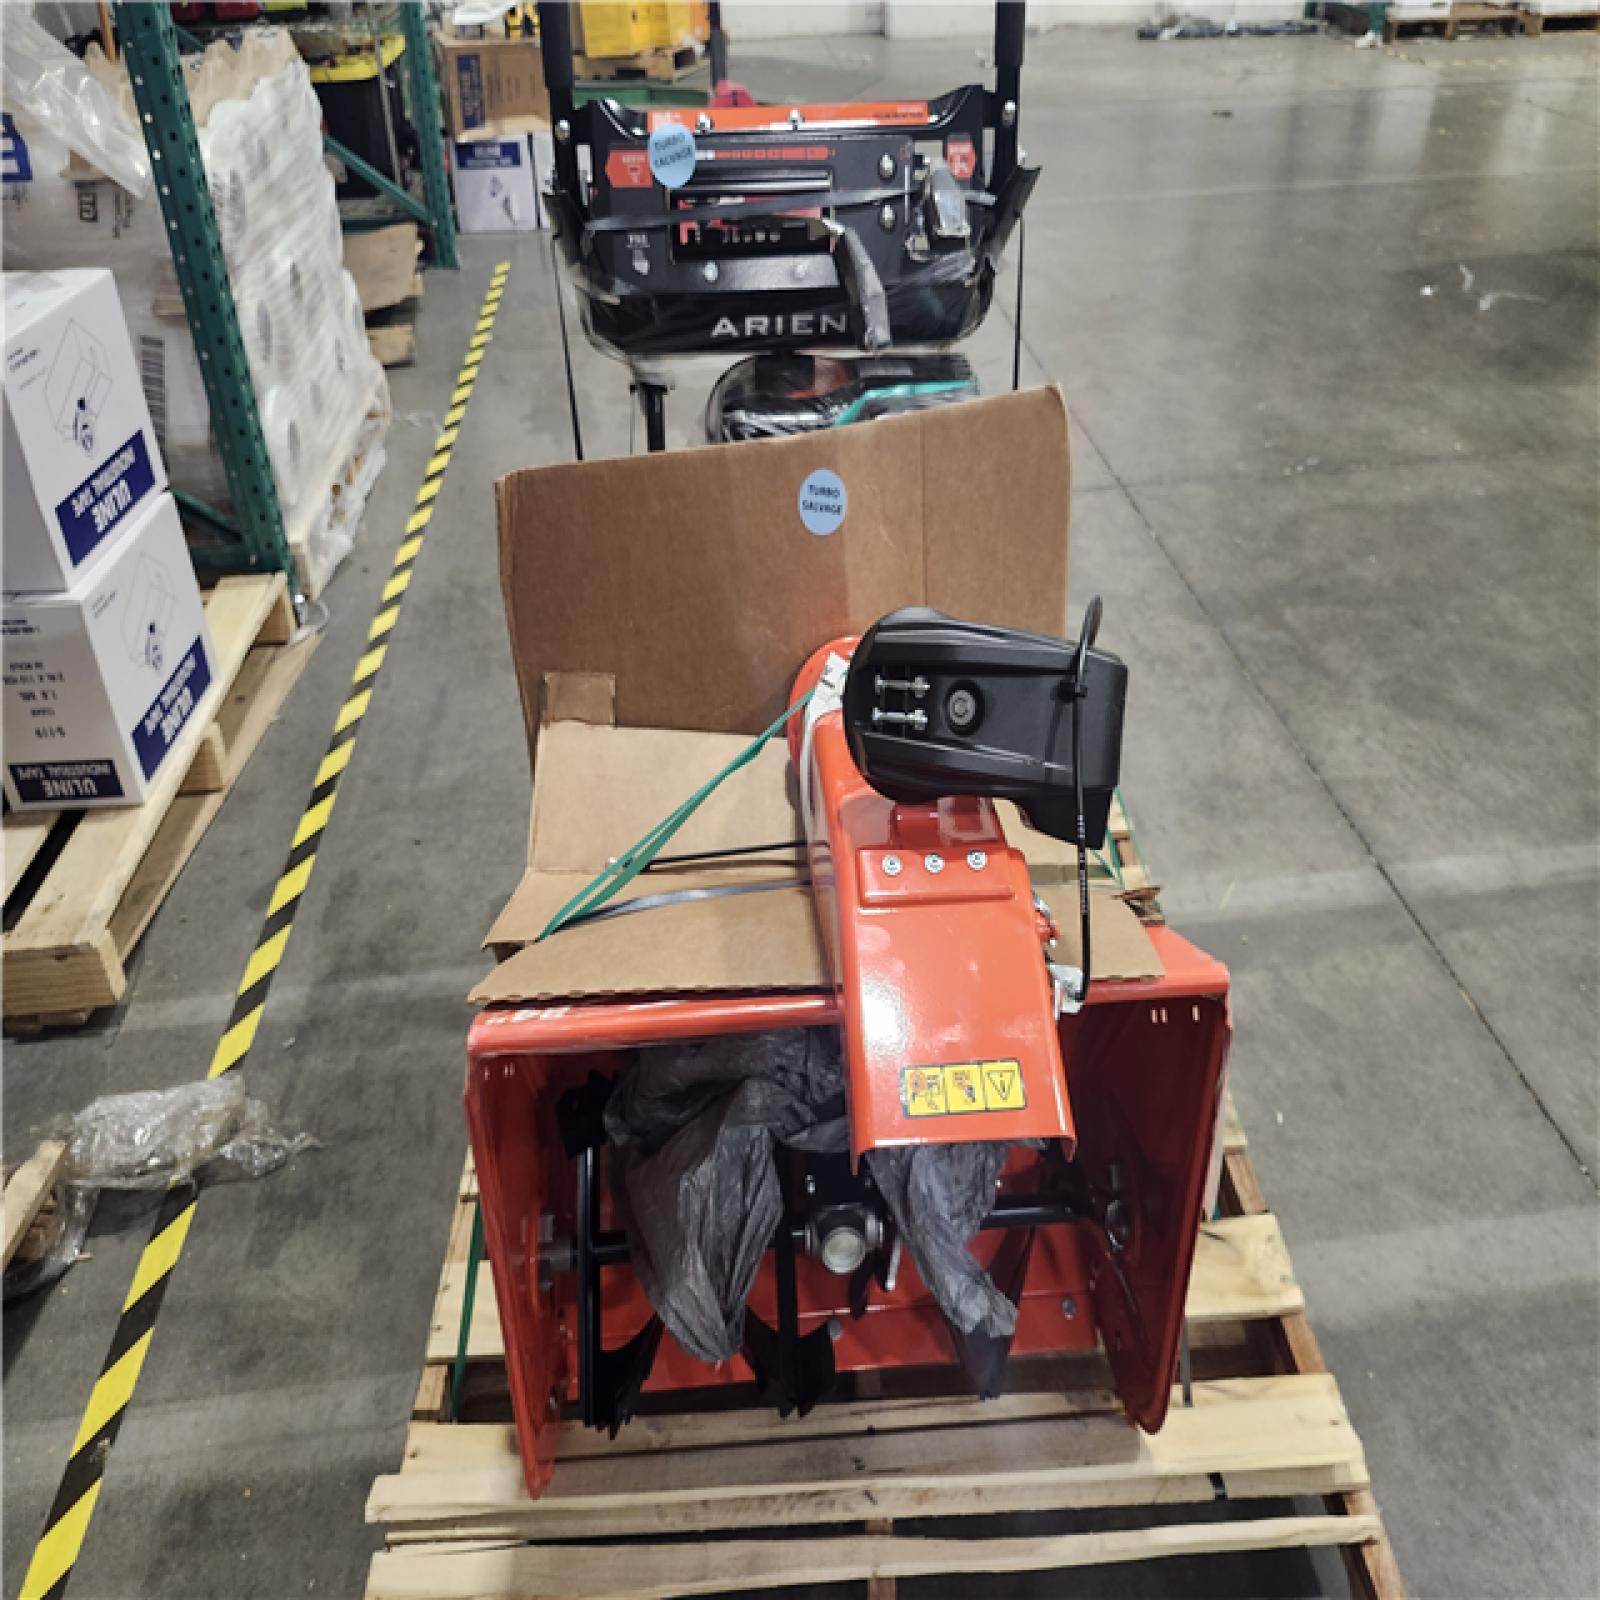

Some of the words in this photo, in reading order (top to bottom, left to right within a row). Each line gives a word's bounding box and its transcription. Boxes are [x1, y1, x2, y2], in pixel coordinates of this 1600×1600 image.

[654, 133, 686, 150] TURBO
[653, 146, 692, 168] SALVAGE
[808, 485, 841, 498] TURBO
[92, 479, 132, 533] ULINE
[802, 499, 843, 516] SALVAGE
[162, 687, 193, 745] ULINE
[42, 777, 98, 797] ULINE
